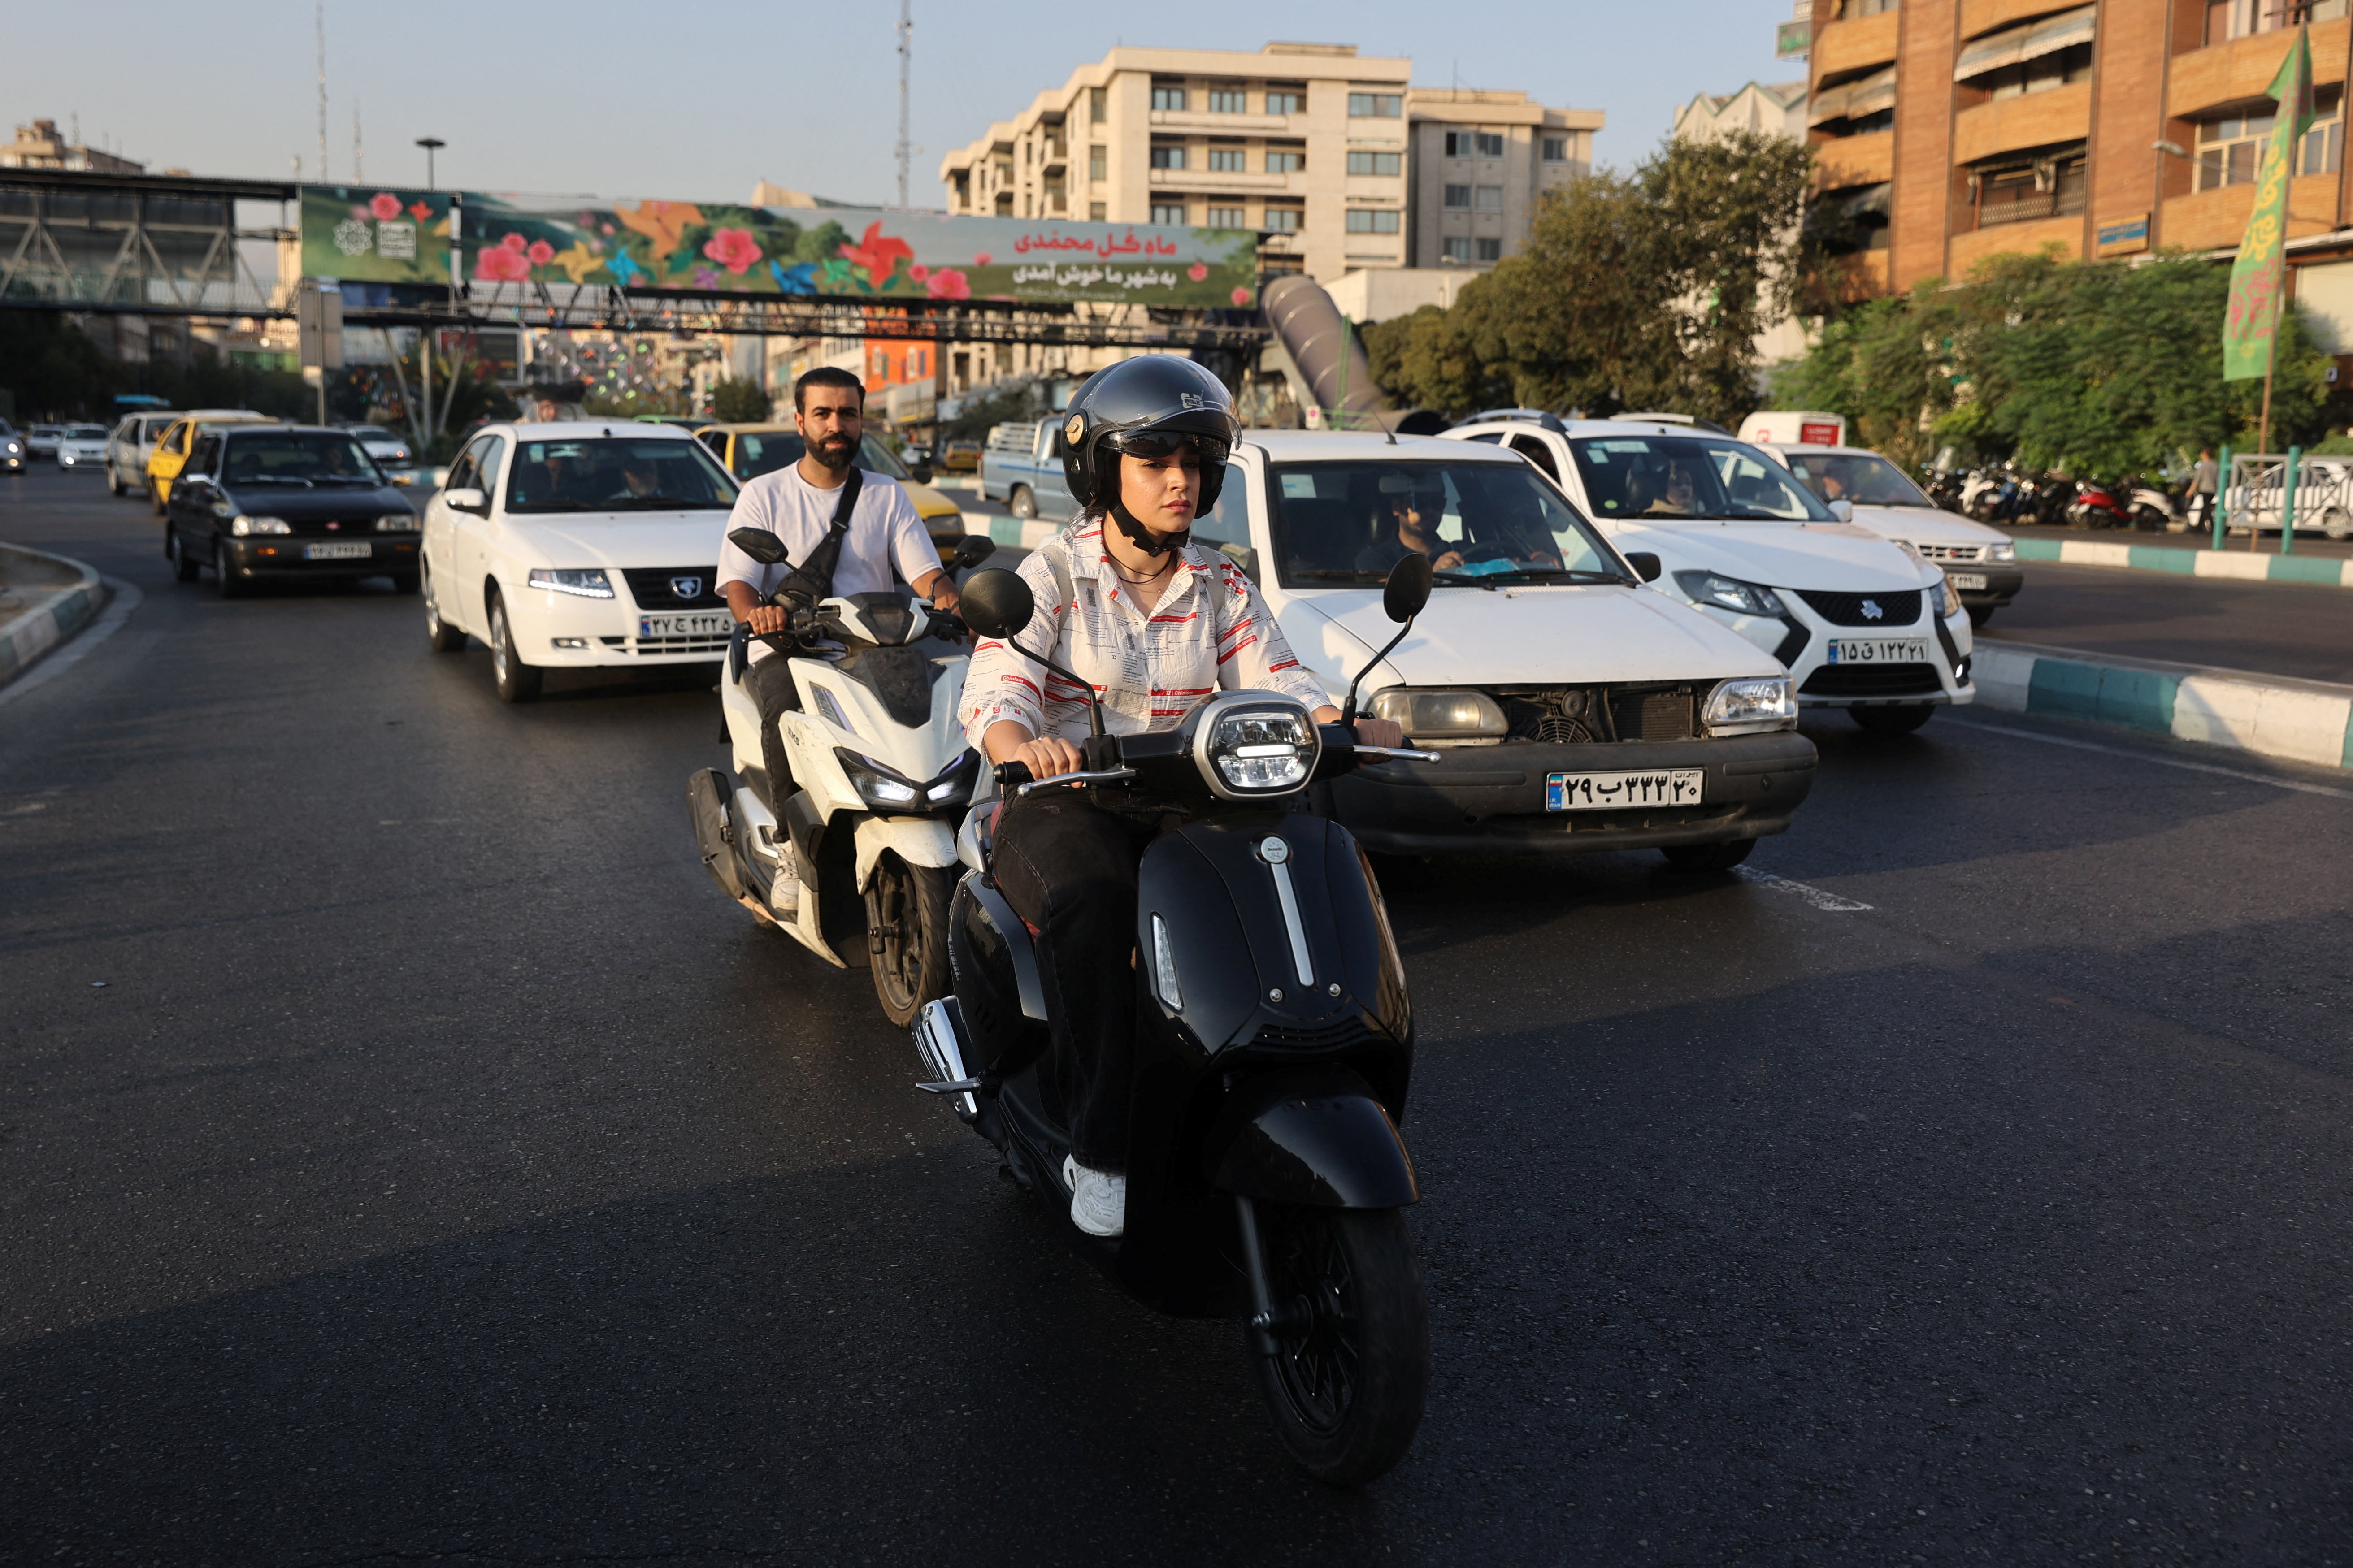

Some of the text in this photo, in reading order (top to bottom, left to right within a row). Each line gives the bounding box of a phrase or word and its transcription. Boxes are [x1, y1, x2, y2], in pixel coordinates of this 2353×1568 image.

[1012, 260, 1178, 290] به شهر ما خوش آمدی
[1841, 642, 1858, 660] ۱۵
[1862, 642, 1874, 659] ق
[1049, 676, 1066, 684] Chinism
[1566, 775, 1697, 805] ۲۹ ب ۳۳۳ ۲۰
